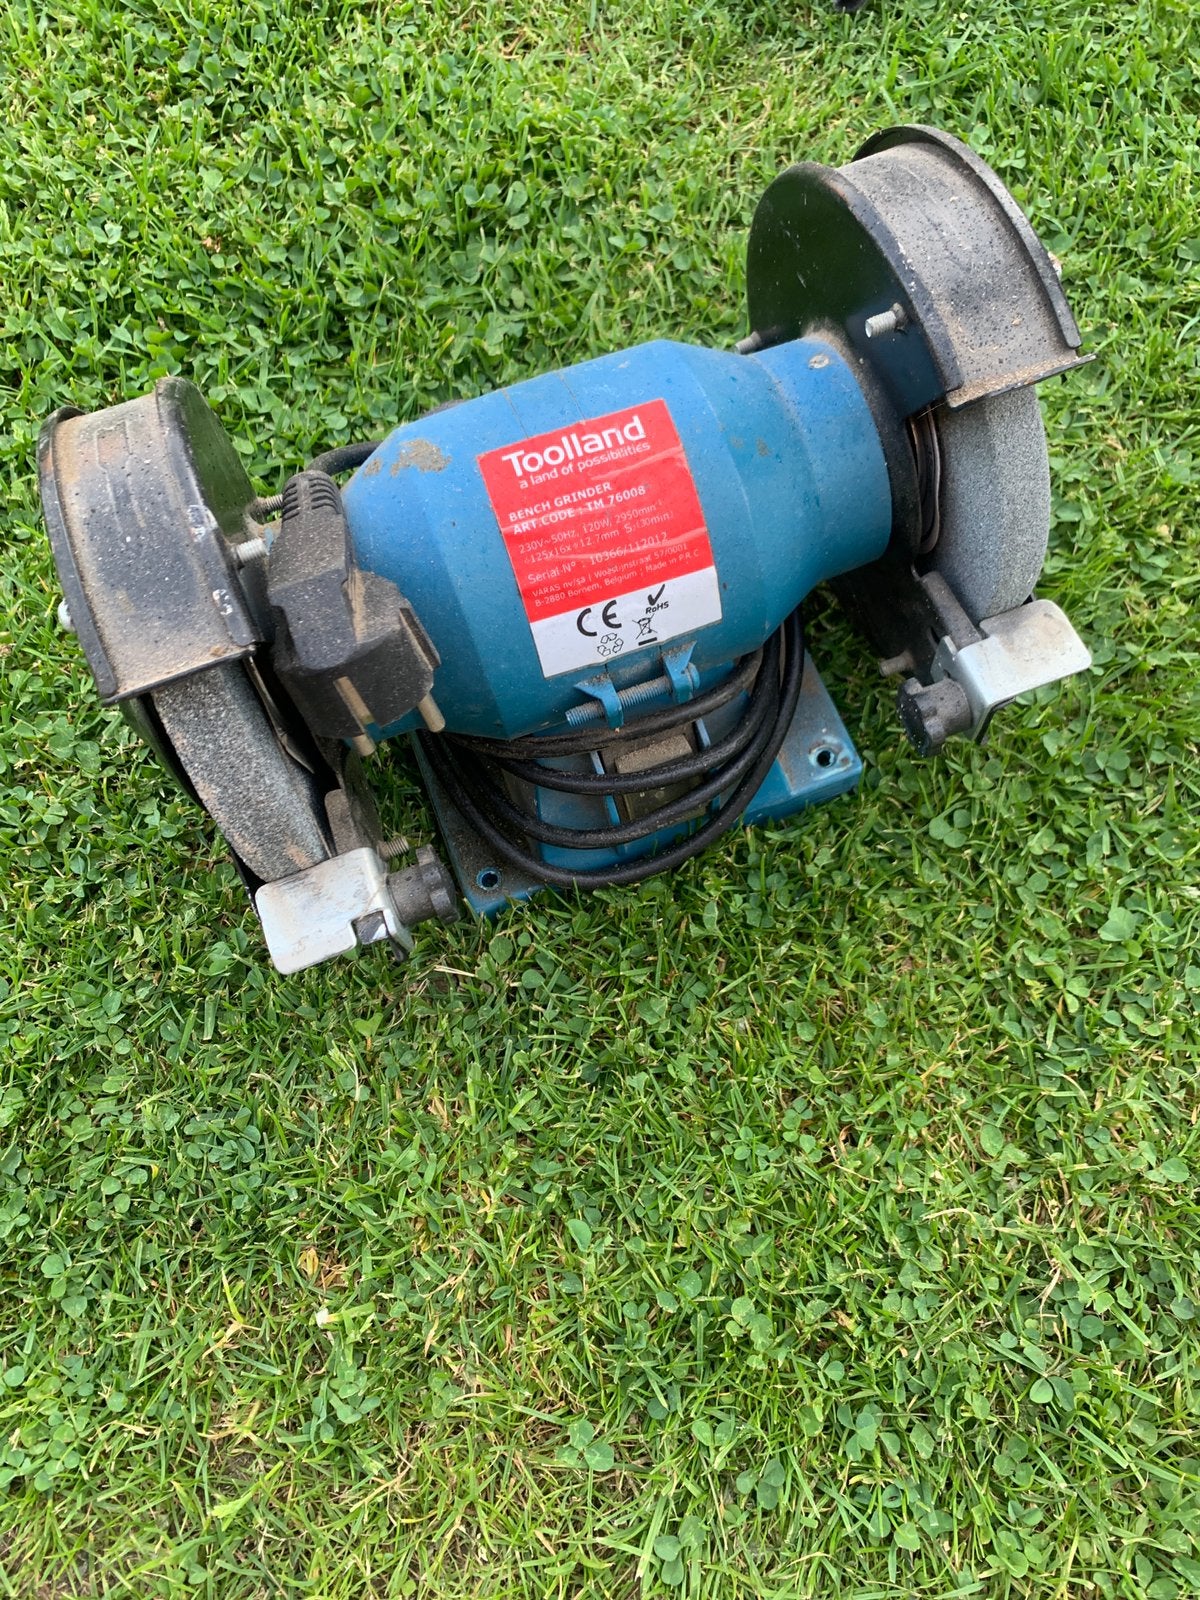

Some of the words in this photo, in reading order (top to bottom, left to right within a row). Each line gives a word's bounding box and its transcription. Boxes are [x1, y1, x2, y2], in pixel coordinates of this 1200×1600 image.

[502, 414, 647, 477] Toolland
[519, 479, 529, 490] a
[530, 467, 559, 485] land
[561, 462, 574, 476] of
[577, 442, 651, 473] possibilities
[508, 500, 551, 523] BENCH
[554, 482, 612, 507] GRINDER
[586, 498, 605, 512] TM
[608, 485, 647, 505] 76008
[527, 566, 561, 585] Serial
[603, 571, 638, 587] Belgium
[645, 559, 668, 573] Made
[532, 583, 561, 598] VARAS
[576, 599, 623, 637] CE
[645, 601, 670, 615] RoHS
